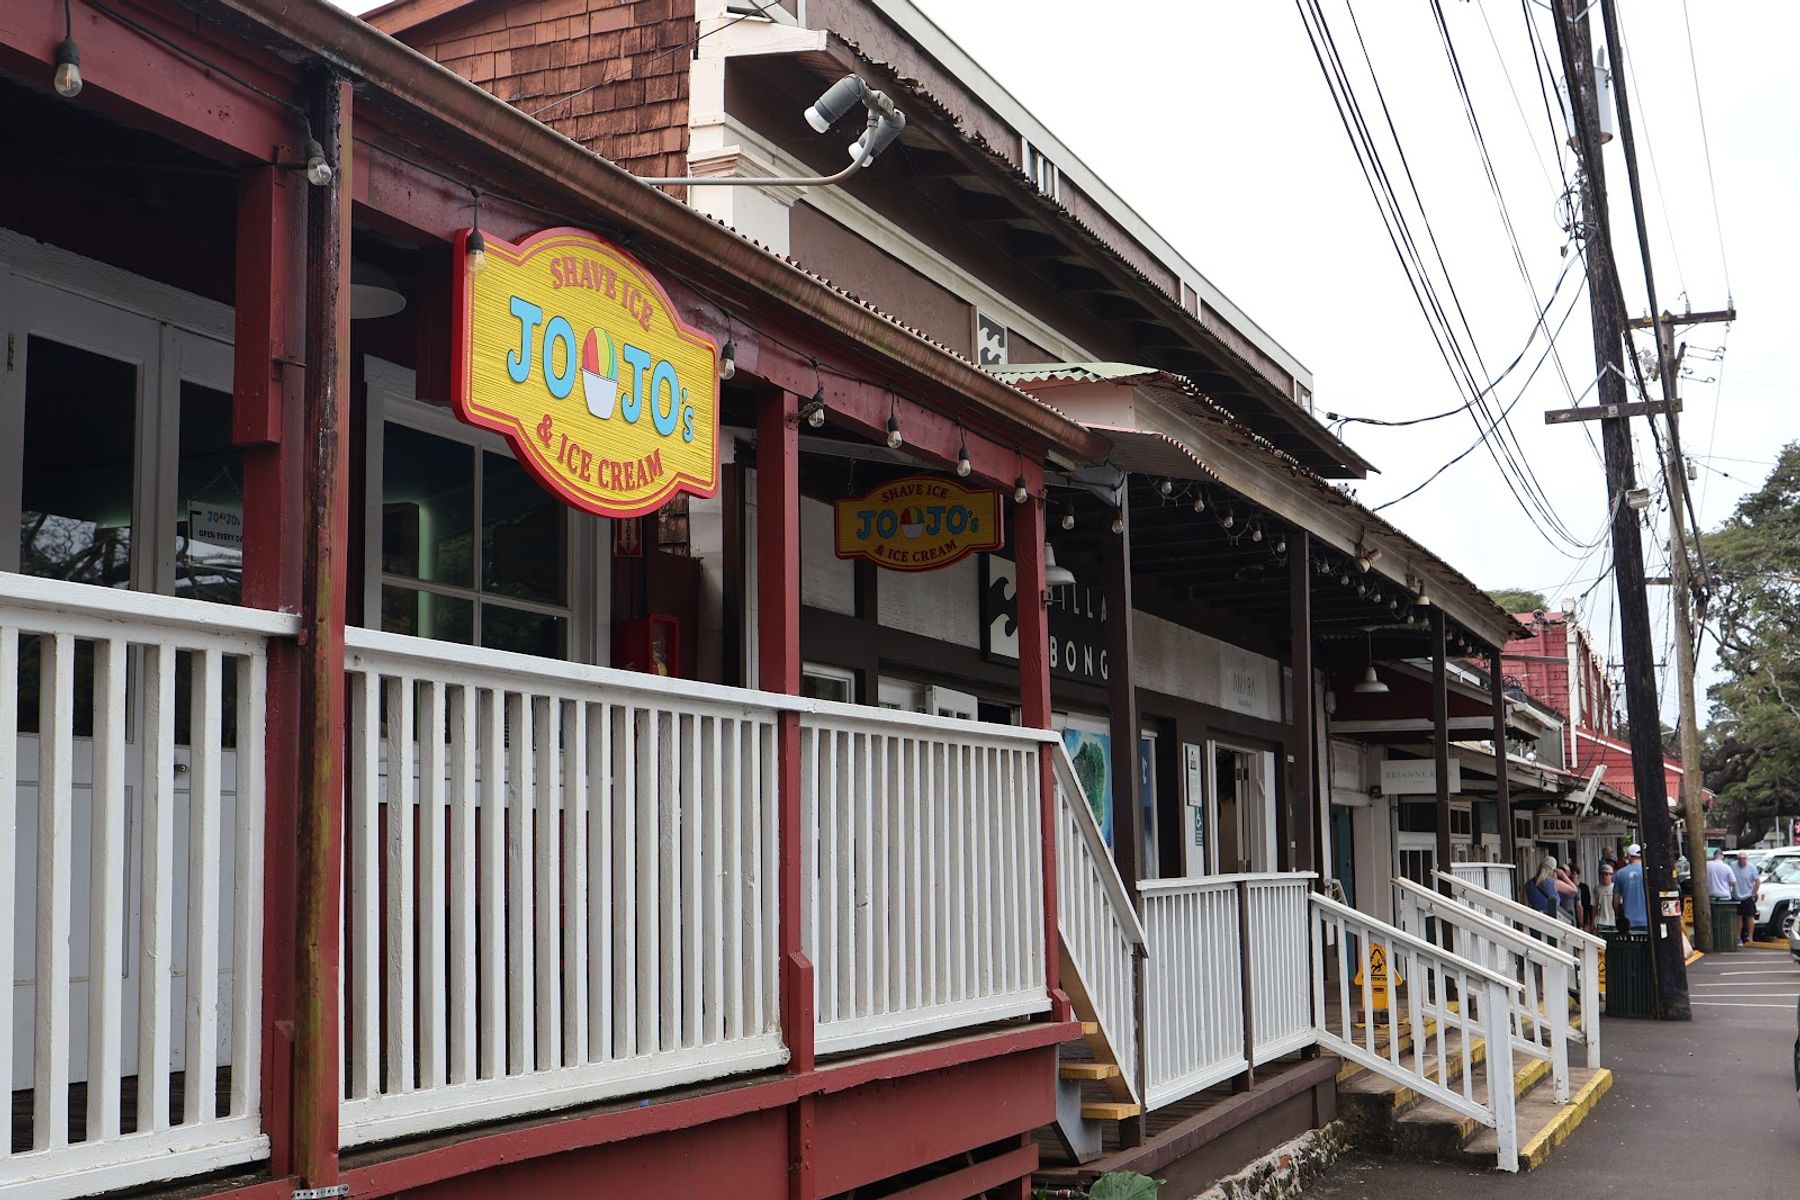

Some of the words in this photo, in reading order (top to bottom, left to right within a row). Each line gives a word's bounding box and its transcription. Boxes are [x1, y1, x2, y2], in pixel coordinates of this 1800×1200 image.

[550, 256, 617, 298] SHAVE
[623, 279, 654, 332] ICE
[536, 414, 553, 448] &
[557, 433, 592, 482] ICE
[598, 448, 664, 492] CREAM
[881, 483, 924, 503] SHAVE
[927, 485, 949, 500] ICE
[199, 530, 215, 539] OPEN
[216, 532, 234, 542] EVERY
[875, 544, 884, 556] &
[887, 550, 909, 563] ICE
[912, 539, 958, 563] CREAM
[1050, 635, 1108, 680] BONG
